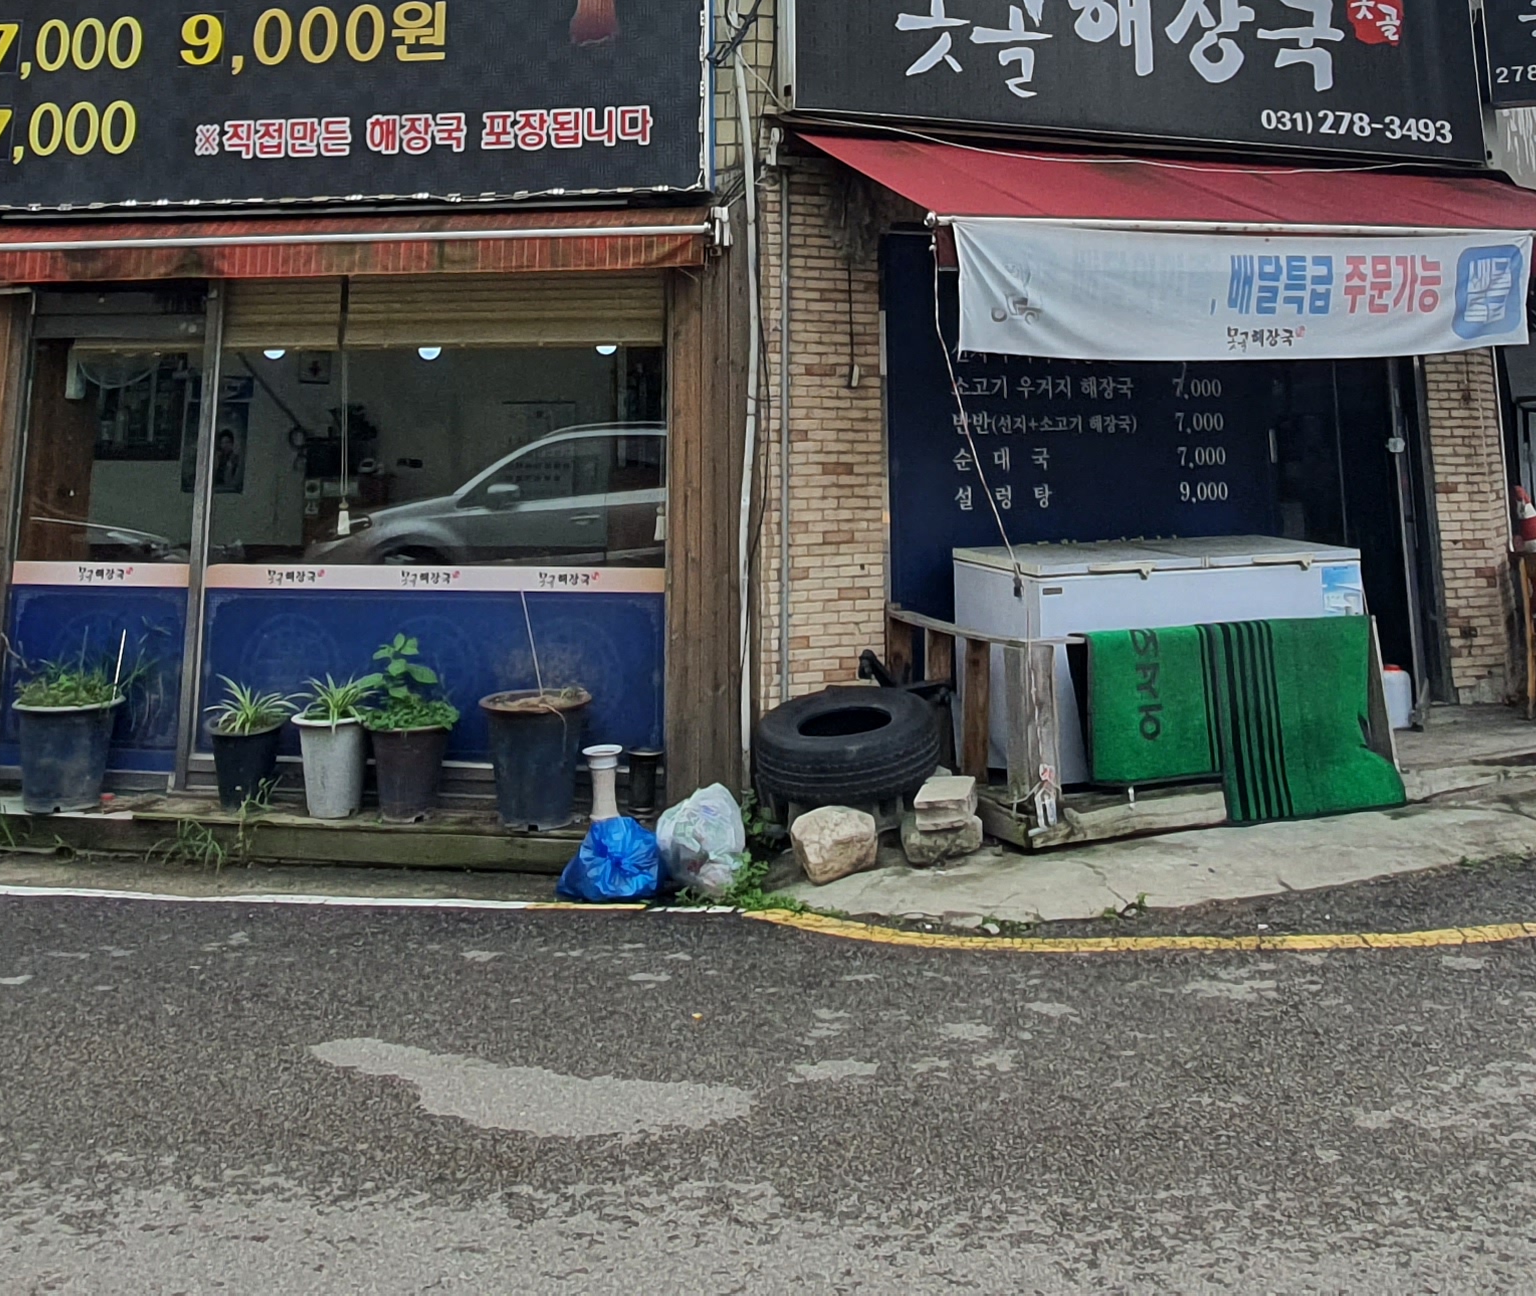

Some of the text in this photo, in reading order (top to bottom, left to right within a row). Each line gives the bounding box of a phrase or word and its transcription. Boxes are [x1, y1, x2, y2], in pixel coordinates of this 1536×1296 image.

[181, 1, 447, 75] 9,000원
[366, 112, 465, 154] 해장국
[481, 106, 653, 150] 포장됩니다
[1261, 108, 1453, 144] 031) 278-3493
[1227, 255, 1332, 315] 배달특급
[1343, 255, 1441, 313] 주문가능
[951, 377, 1008, 398] 소고기
[1017, 377, 1071, 398] 우거지
[1080, 377, 1134, 398] 해장국
